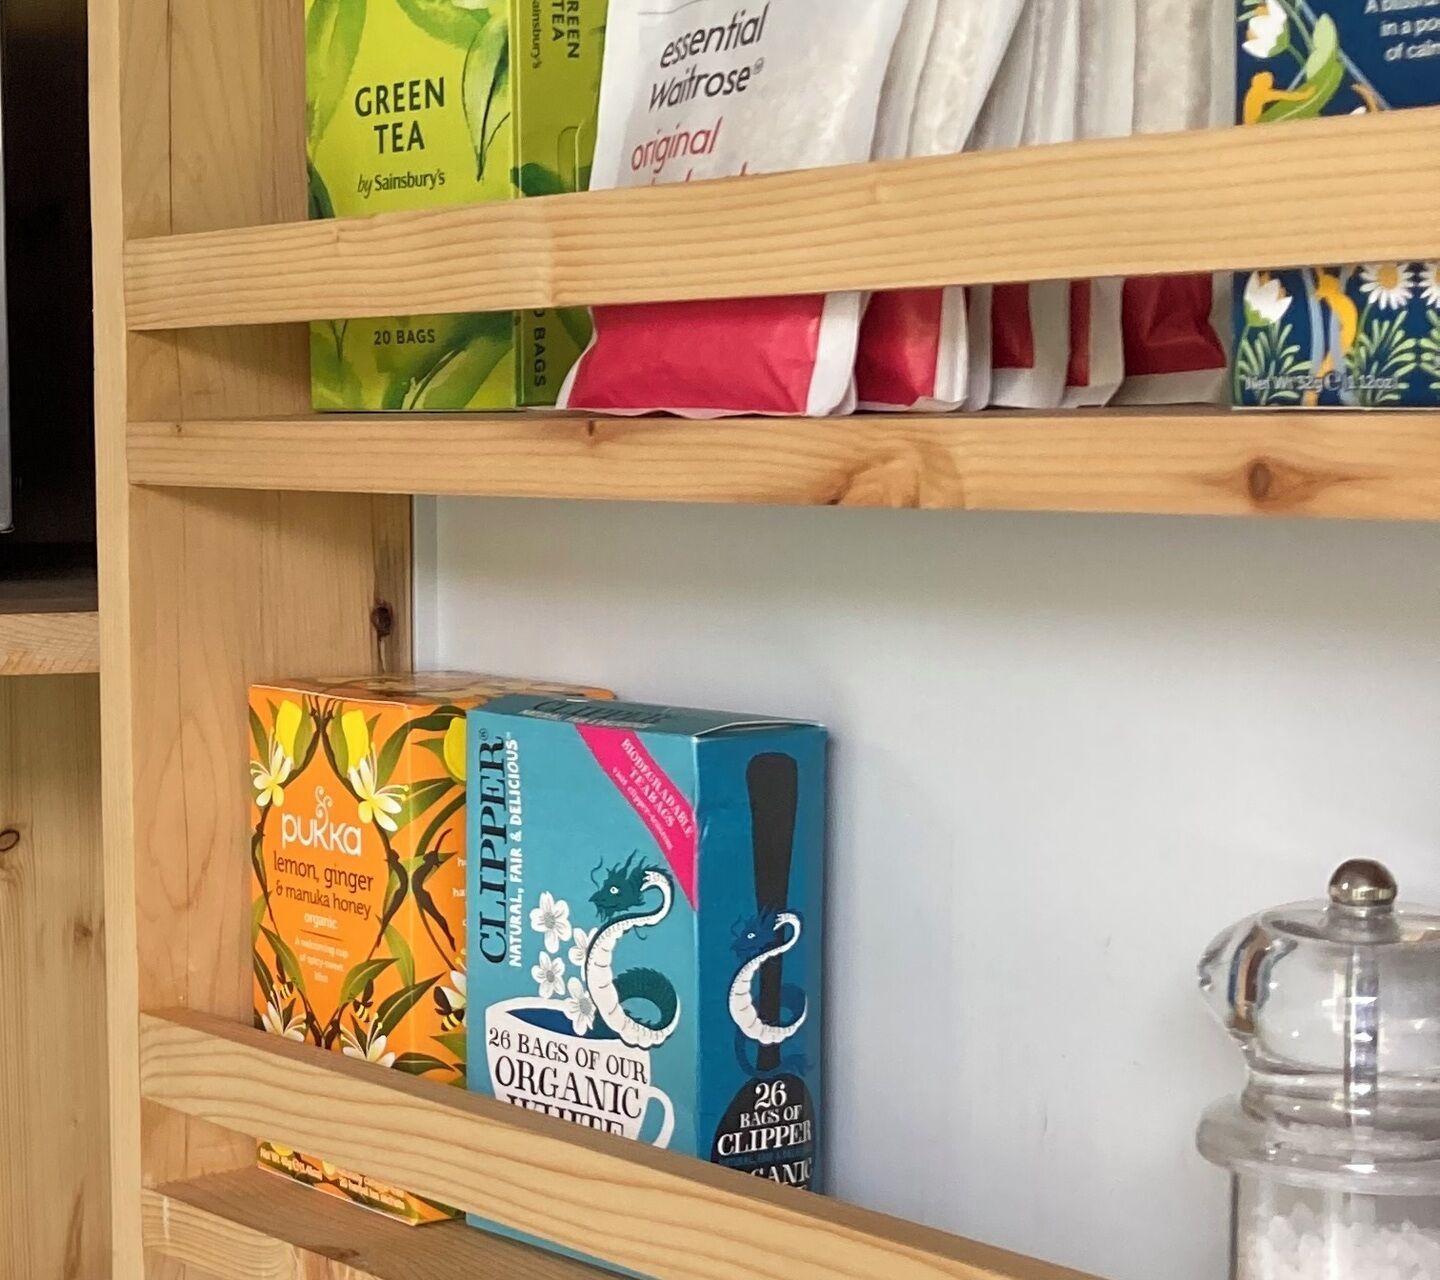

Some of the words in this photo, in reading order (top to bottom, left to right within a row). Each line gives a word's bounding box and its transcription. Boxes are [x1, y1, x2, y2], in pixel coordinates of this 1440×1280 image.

[552, 0, 565, 41] TEA
[661, 1, 770, 68] essential
[1380, 20, 1397, 37] in
[1401, 21, 1411, 34] a
[1385, 42, 1405, 62] of
[355, 77, 445, 117] GREEN
[374, 120, 425, 154] TEA
[631, 116, 723, 173] original
[357, 174, 373, 199] by
[375, 168, 445, 191] Sainsbury's
[374, 330, 391, 346] 20
[396, 329, 436, 345] BAGS
[533, 328, 547, 387] BAGS
[506, 738, 523, 826] DELICIOUS
[282, 813, 362, 856] pukka
[479, 736, 507, 964] CLIPPER
[510, 830, 522, 842] &
[273, 850, 320, 883] lemon,
[324, 865, 374, 894] ginger
[509, 847, 523, 883] FAIR
[276, 880, 284, 896] &
[286, 886, 330, 908] manuka
[332, 893, 372, 921] honey
[509, 887, 524, 968] NATURAL,
[489, 1027, 511, 1050] 26
[517, 1033, 569, 1063] BAGS
[575, 1047, 600, 1070] OF
[606, 1054, 648, 1084] OUR
[495, 1055, 642, 1119] ORGANIC
[754, 1080, 787, 1110] 26
[740, 1109, 780, 1128] BAGS
[783, 1105, 802, 1121] OF
[717, 1120, 812, 1156] CLIPPER
